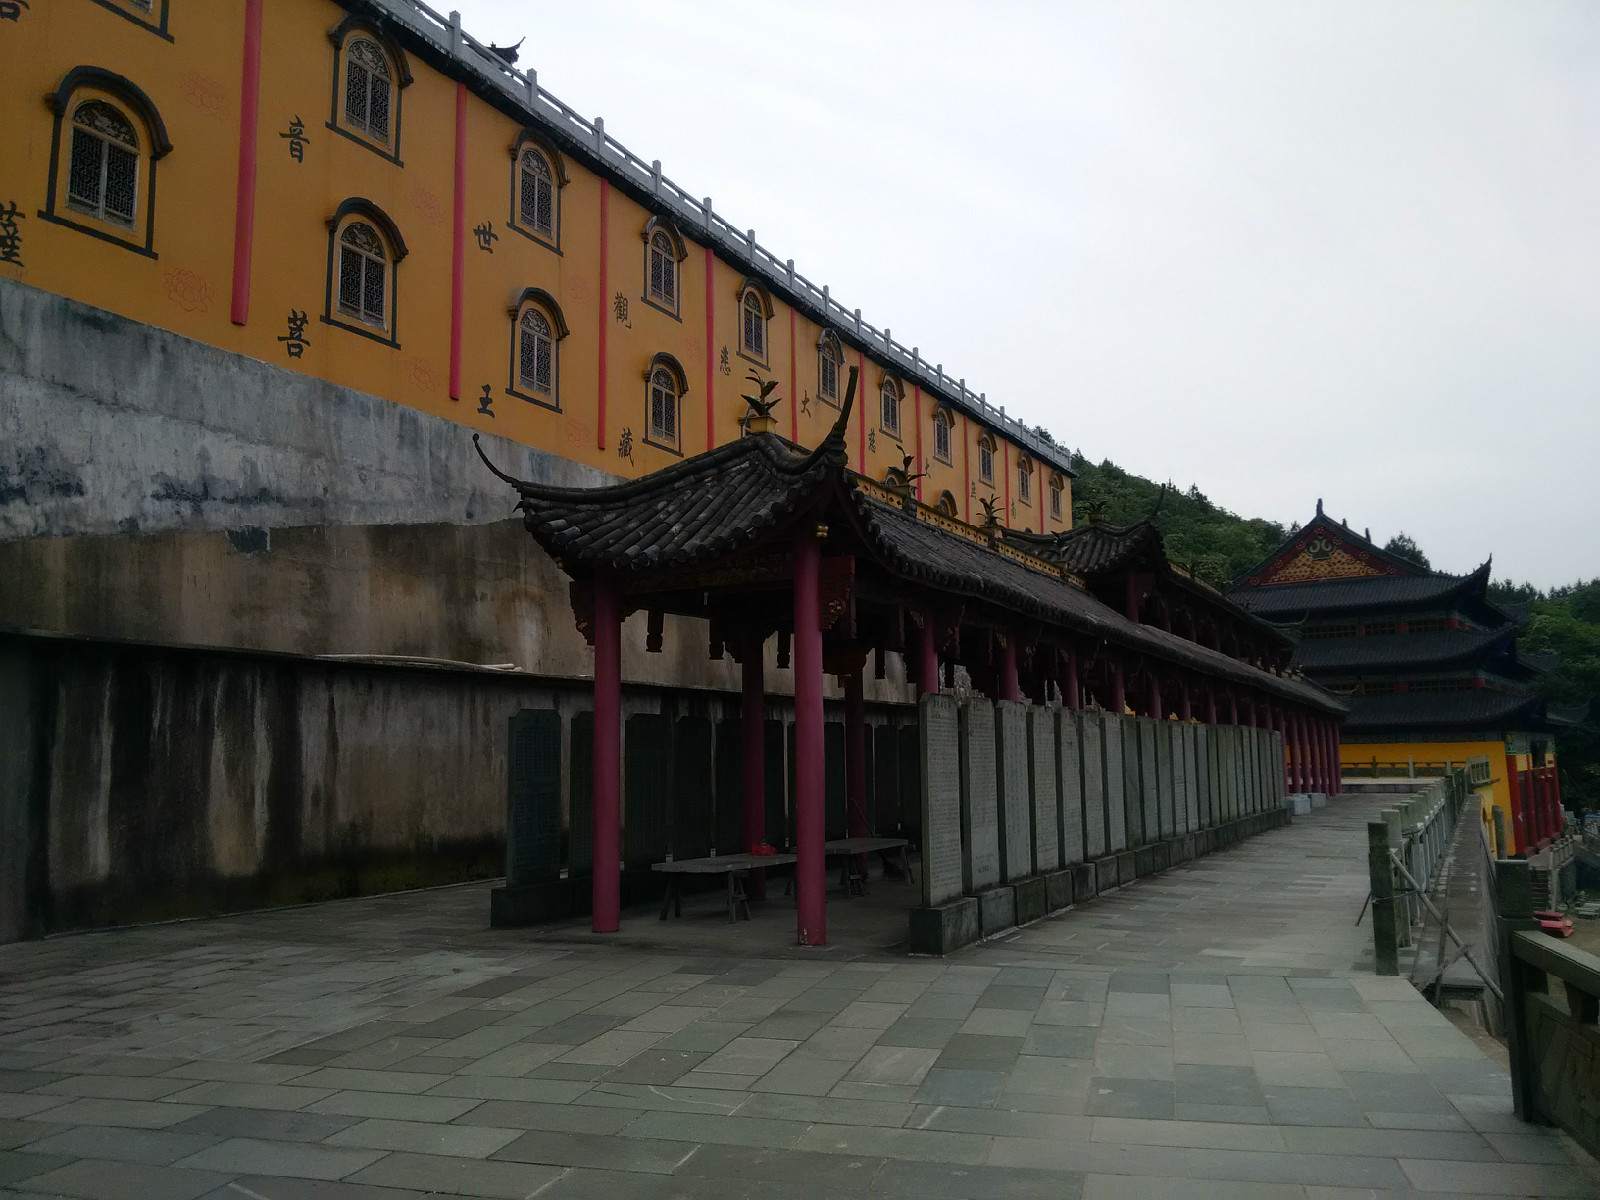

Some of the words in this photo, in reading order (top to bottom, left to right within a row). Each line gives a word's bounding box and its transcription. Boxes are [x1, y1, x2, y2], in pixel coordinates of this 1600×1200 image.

[279, 115, 310, 163] 音
[473, 221, 499, 254] 世
[613, 291, 632, 329] 觀
[277, 309, 310, 359] 菩
[476, 384, 495, 418] 王
[800, 390, 812, 418] 大
[617, 428, 635, 467] 藏
